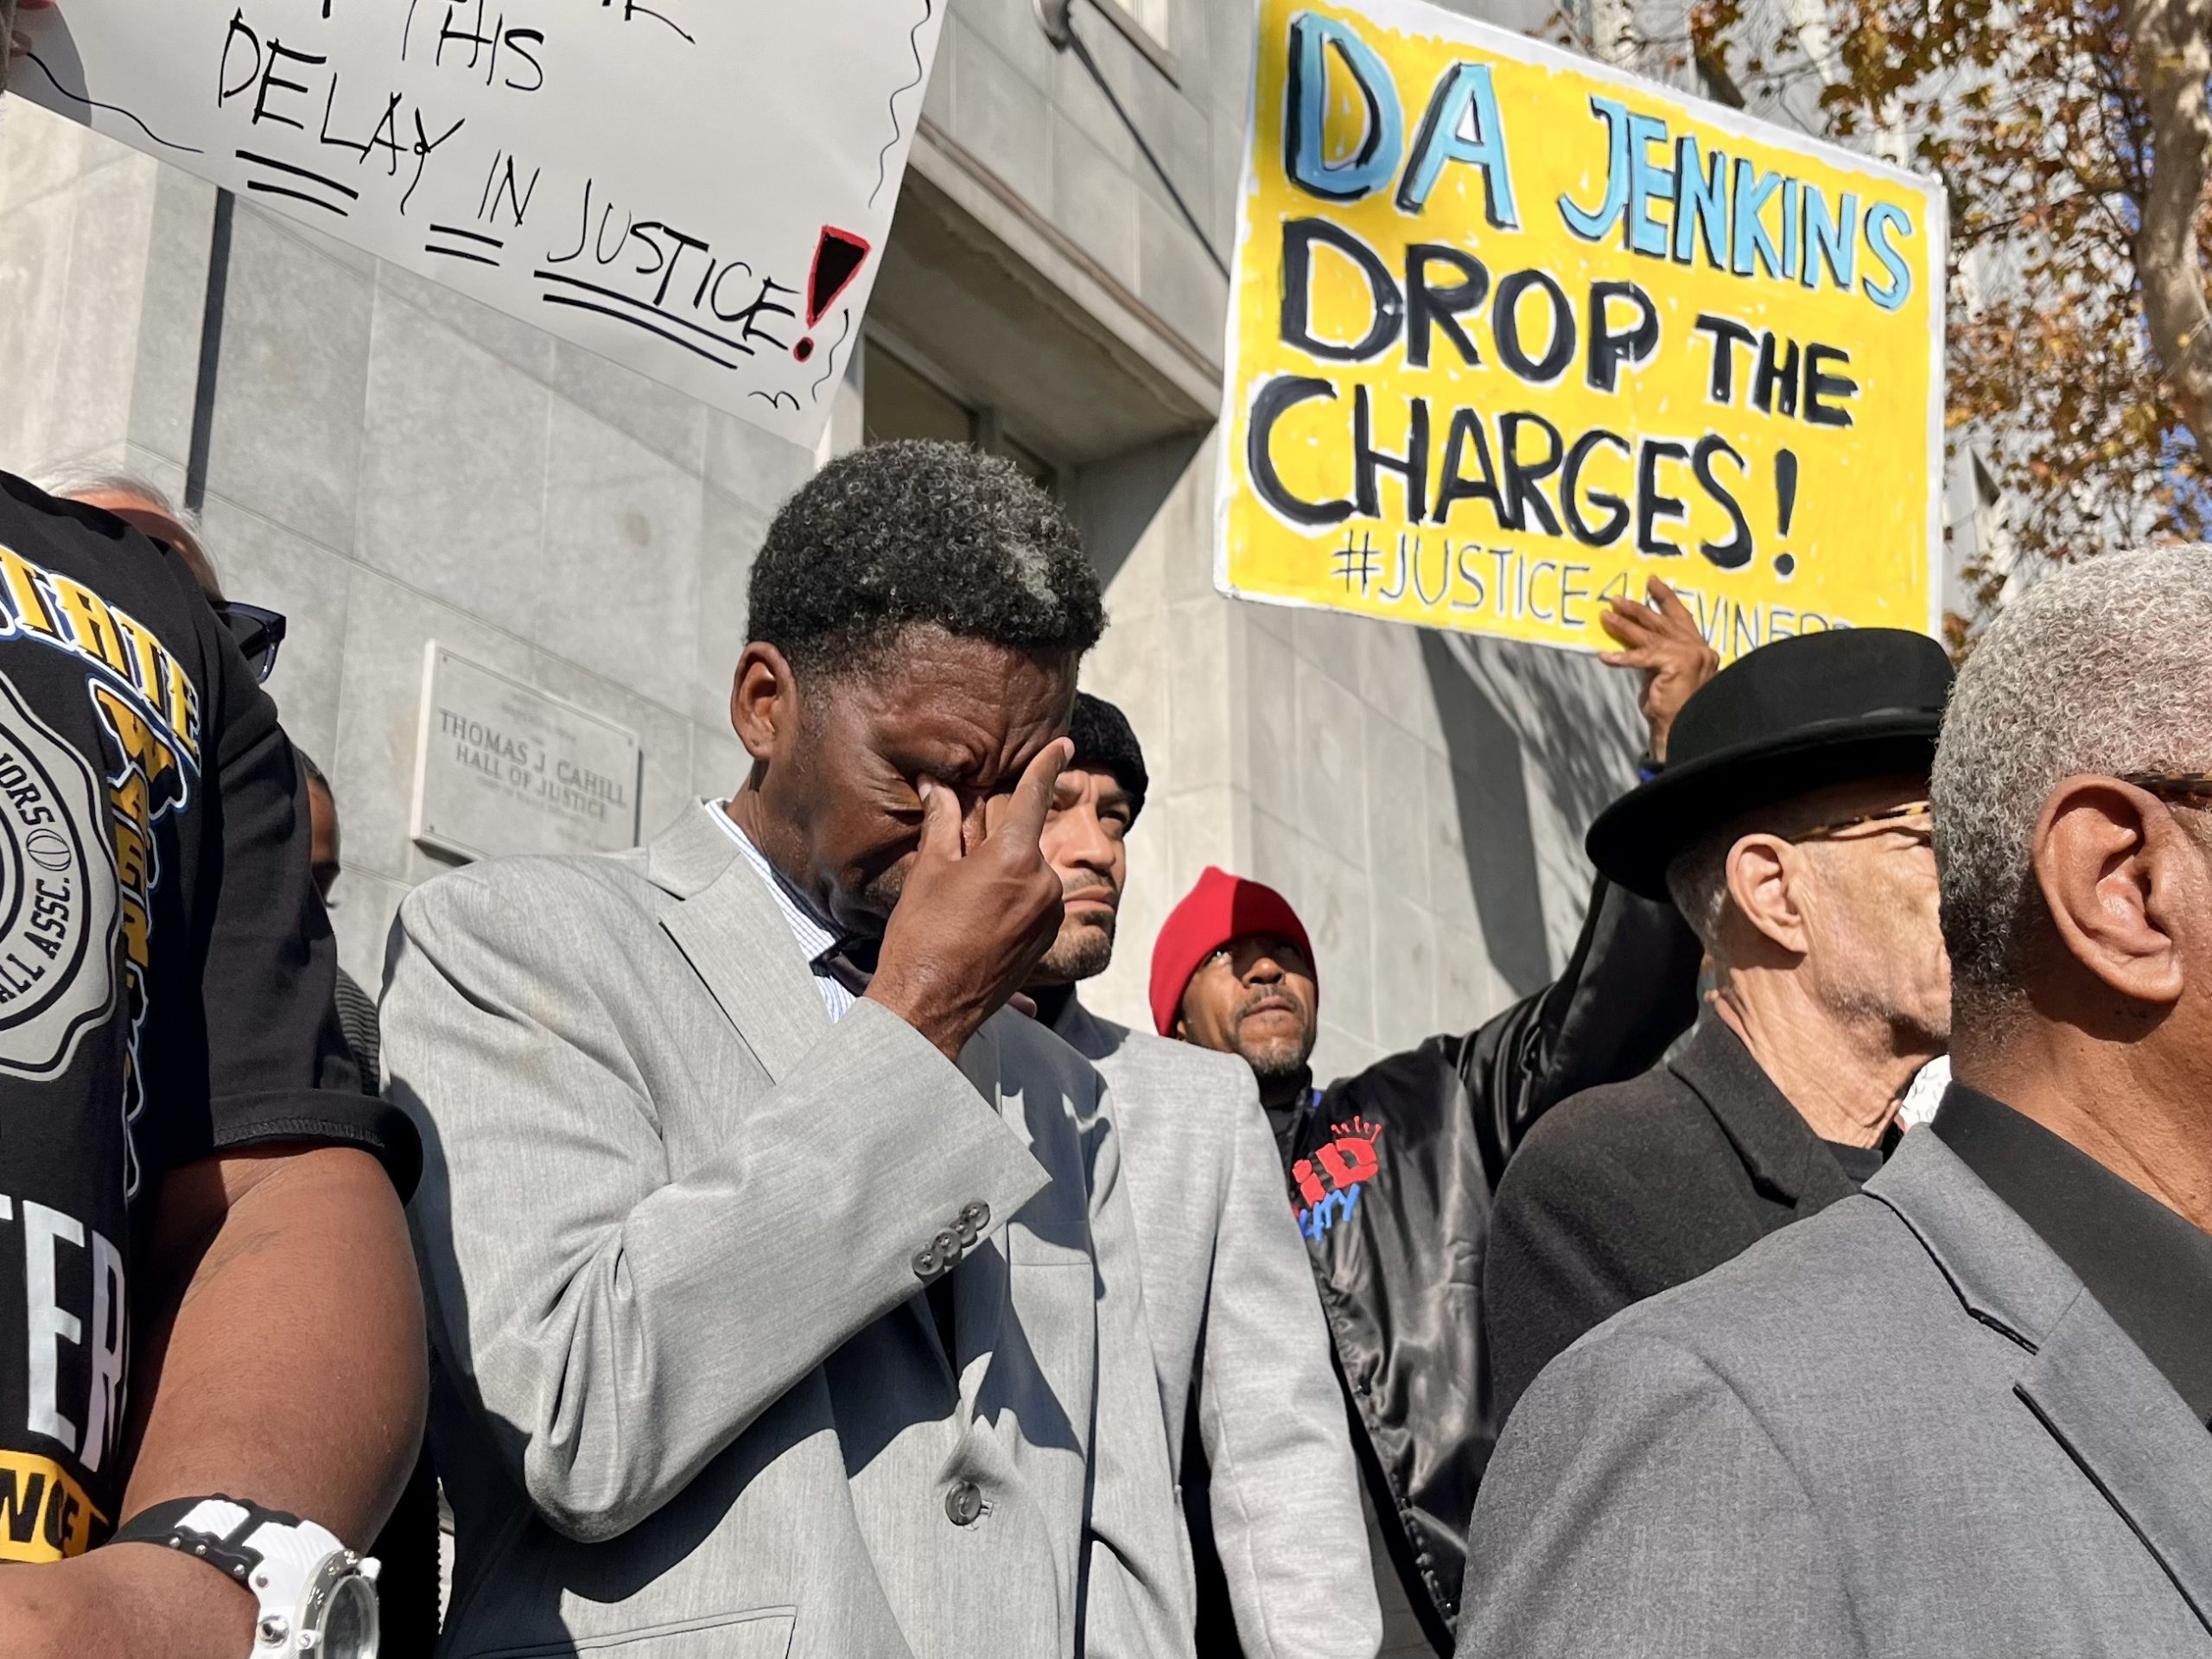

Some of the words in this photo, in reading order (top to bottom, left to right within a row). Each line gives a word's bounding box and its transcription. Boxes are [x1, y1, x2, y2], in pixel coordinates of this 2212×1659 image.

[218, 7, 465, 215] DELAY
[478, 149, 540, 227] IN
[402, 0, 544, 91] THIS
[1284, 12, 1518, 230] DA
[1557, 94, 1912, 309] JENKINS
[1281, 218, 1658, 392] DROP
[1695, 314, 1859, 428] THE
[1248, 377, 1798, 578] CHARGES!
[0, 543, 200, 760] TATE
[440, 709, 529, 766] THOMAS
[556, 759, 626, 808] CAHILL
[456, 742, 502, 780] HALL
[510, 767, 531, 791] OF
[535, 776, 608, 823] JUSTICE
[23, 877, 70, 960] ASSC.
